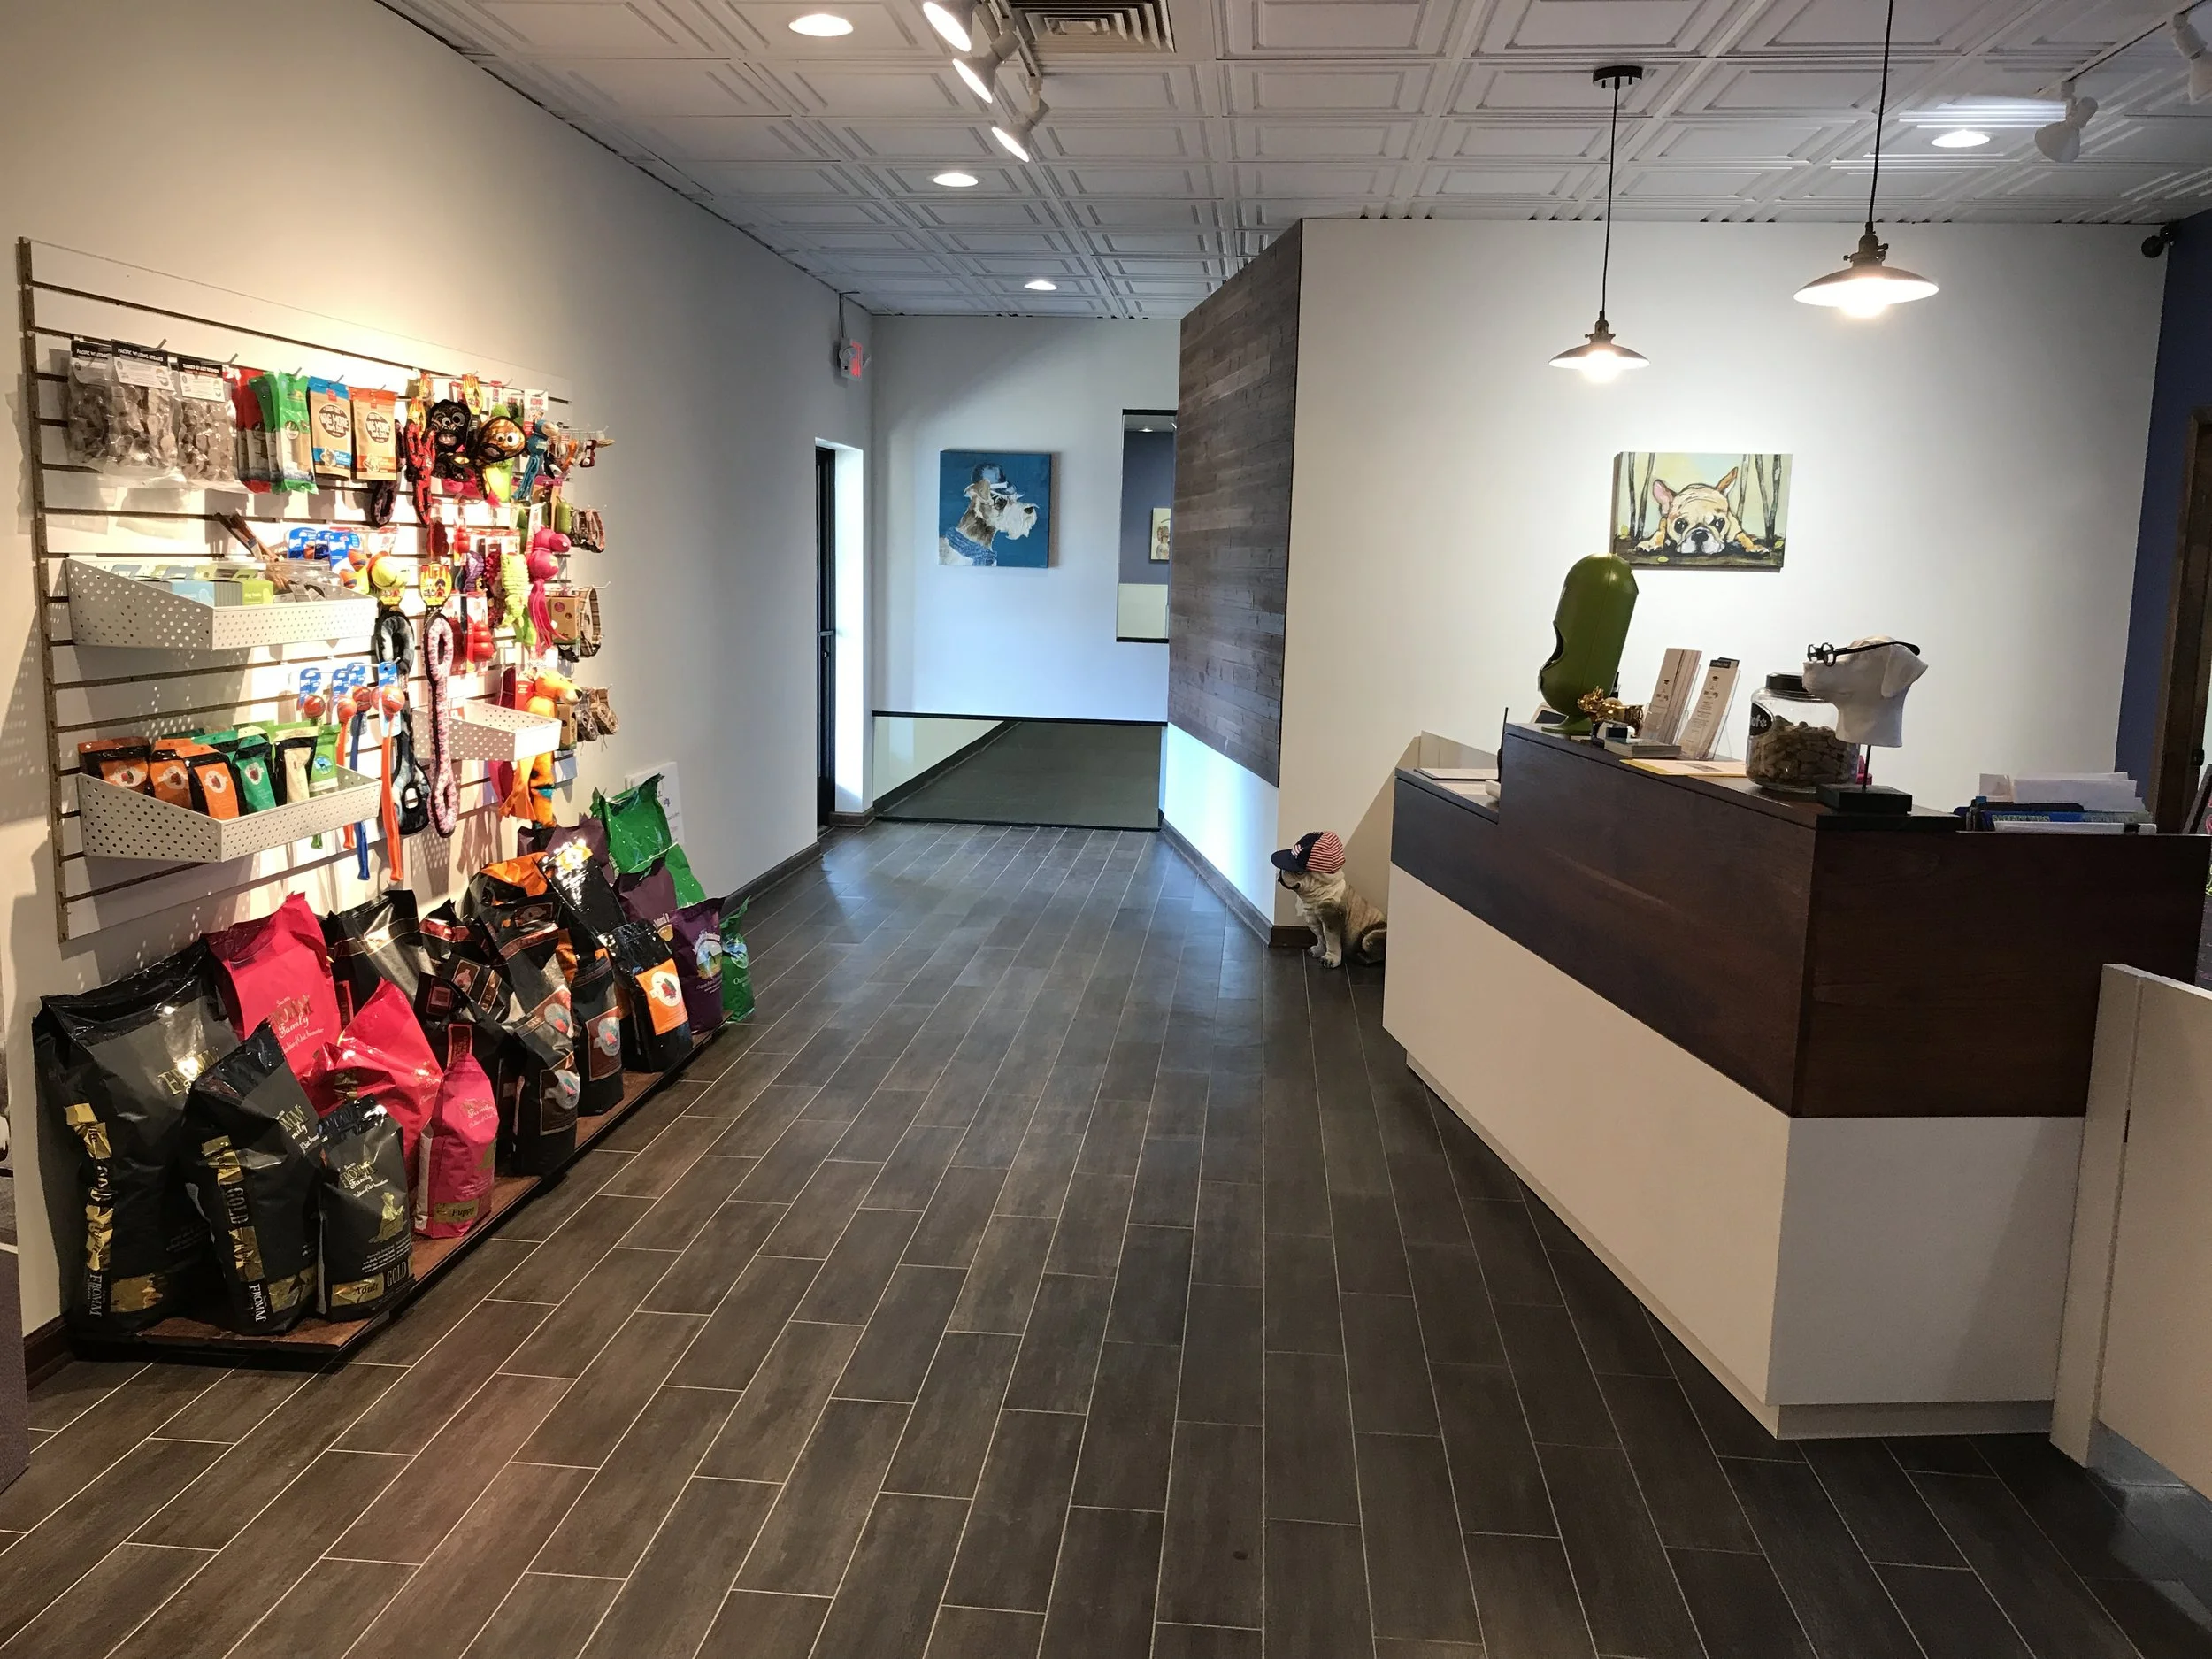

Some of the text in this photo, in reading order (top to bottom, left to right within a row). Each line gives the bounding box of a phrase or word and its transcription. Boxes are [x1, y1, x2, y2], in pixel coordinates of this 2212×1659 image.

[278, 1011, 309, 1039] Family
[291, 1121, 308, 1140] mily
[349, 1171, 373, 1190] Family
[226, 1187, 250, 1225] GOLD
[451, 1207, 475, 1218] Puppy
[355, 1261, 407, 1295] Adult GOLD
[88, 1273, 104, 1317] FROMM
[249, 1283, 267, 1323] FROMM
